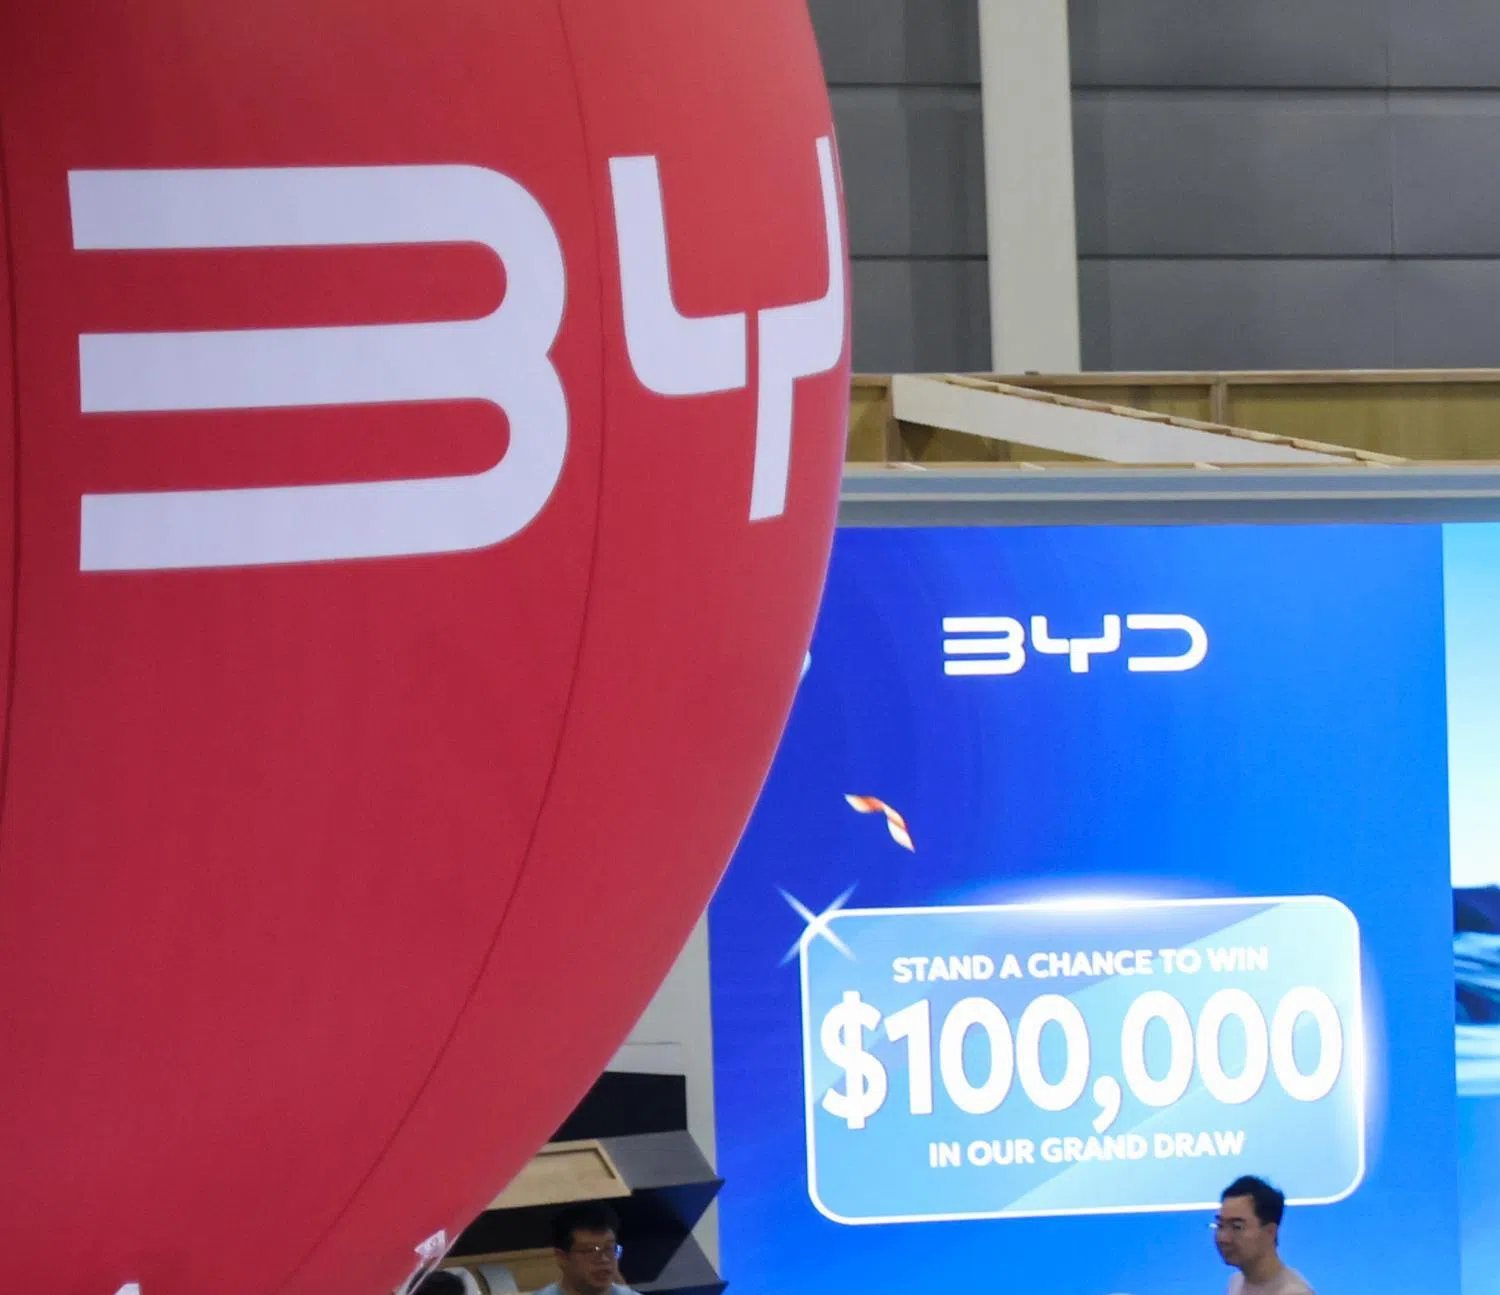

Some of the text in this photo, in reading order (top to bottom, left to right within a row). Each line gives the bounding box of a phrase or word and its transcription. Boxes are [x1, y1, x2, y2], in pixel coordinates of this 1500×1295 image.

[68, 136, 845, 571] BY
[942, 614, 1209, 676] BYD
[893, 947, 1270, 983] STAND A CHANCE TO WIN
[820, 985, 1344, 1132] $100,000
[929, 1131, 1245, 1168] IN OUR GRAND DRAW
